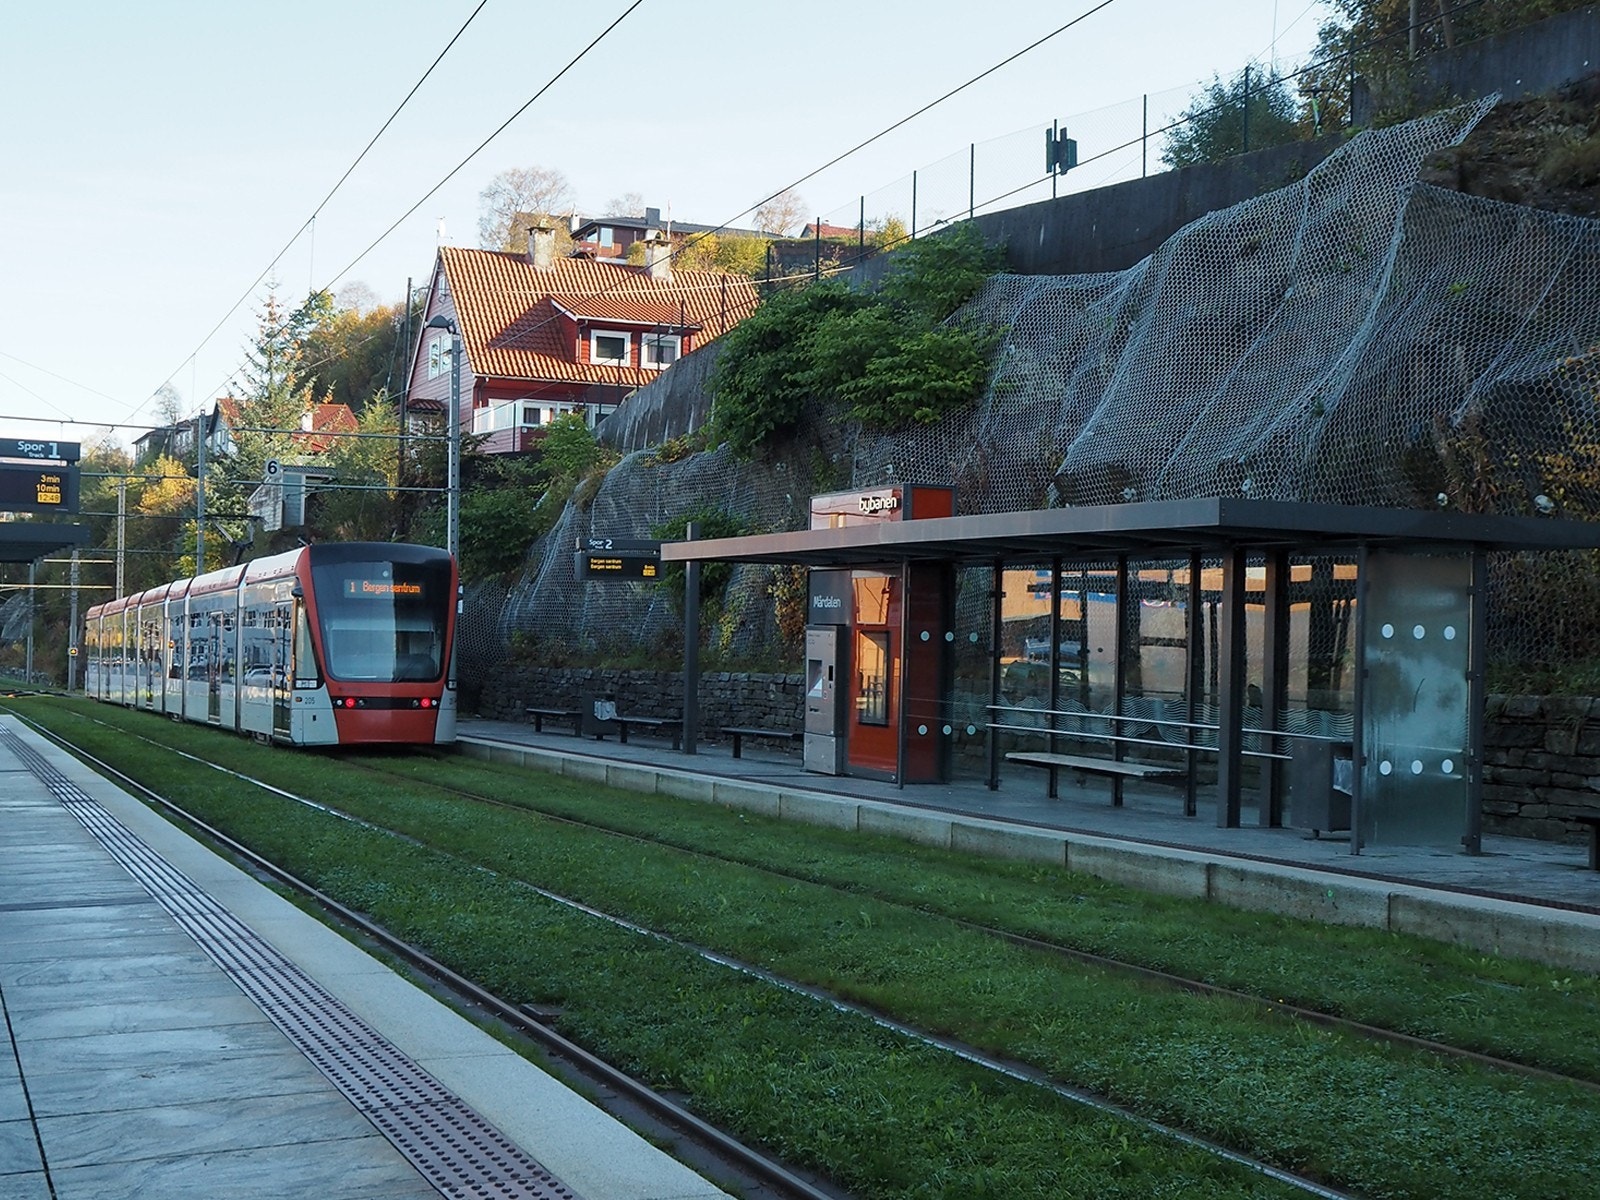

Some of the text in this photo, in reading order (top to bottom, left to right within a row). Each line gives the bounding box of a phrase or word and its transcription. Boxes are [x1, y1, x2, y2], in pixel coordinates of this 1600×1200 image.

[17, 441, 61, 459] Spor 1
[267, 460, 278, 475] 6
[858, 496, 898, 514] bybanen
[588, 538, 604, 546] Spor
[605, 539, 613, 550] 2
[350, 580, 421, 595] 1 Bergen sentrum
[813, 595, 842, 608] Mårdalen
